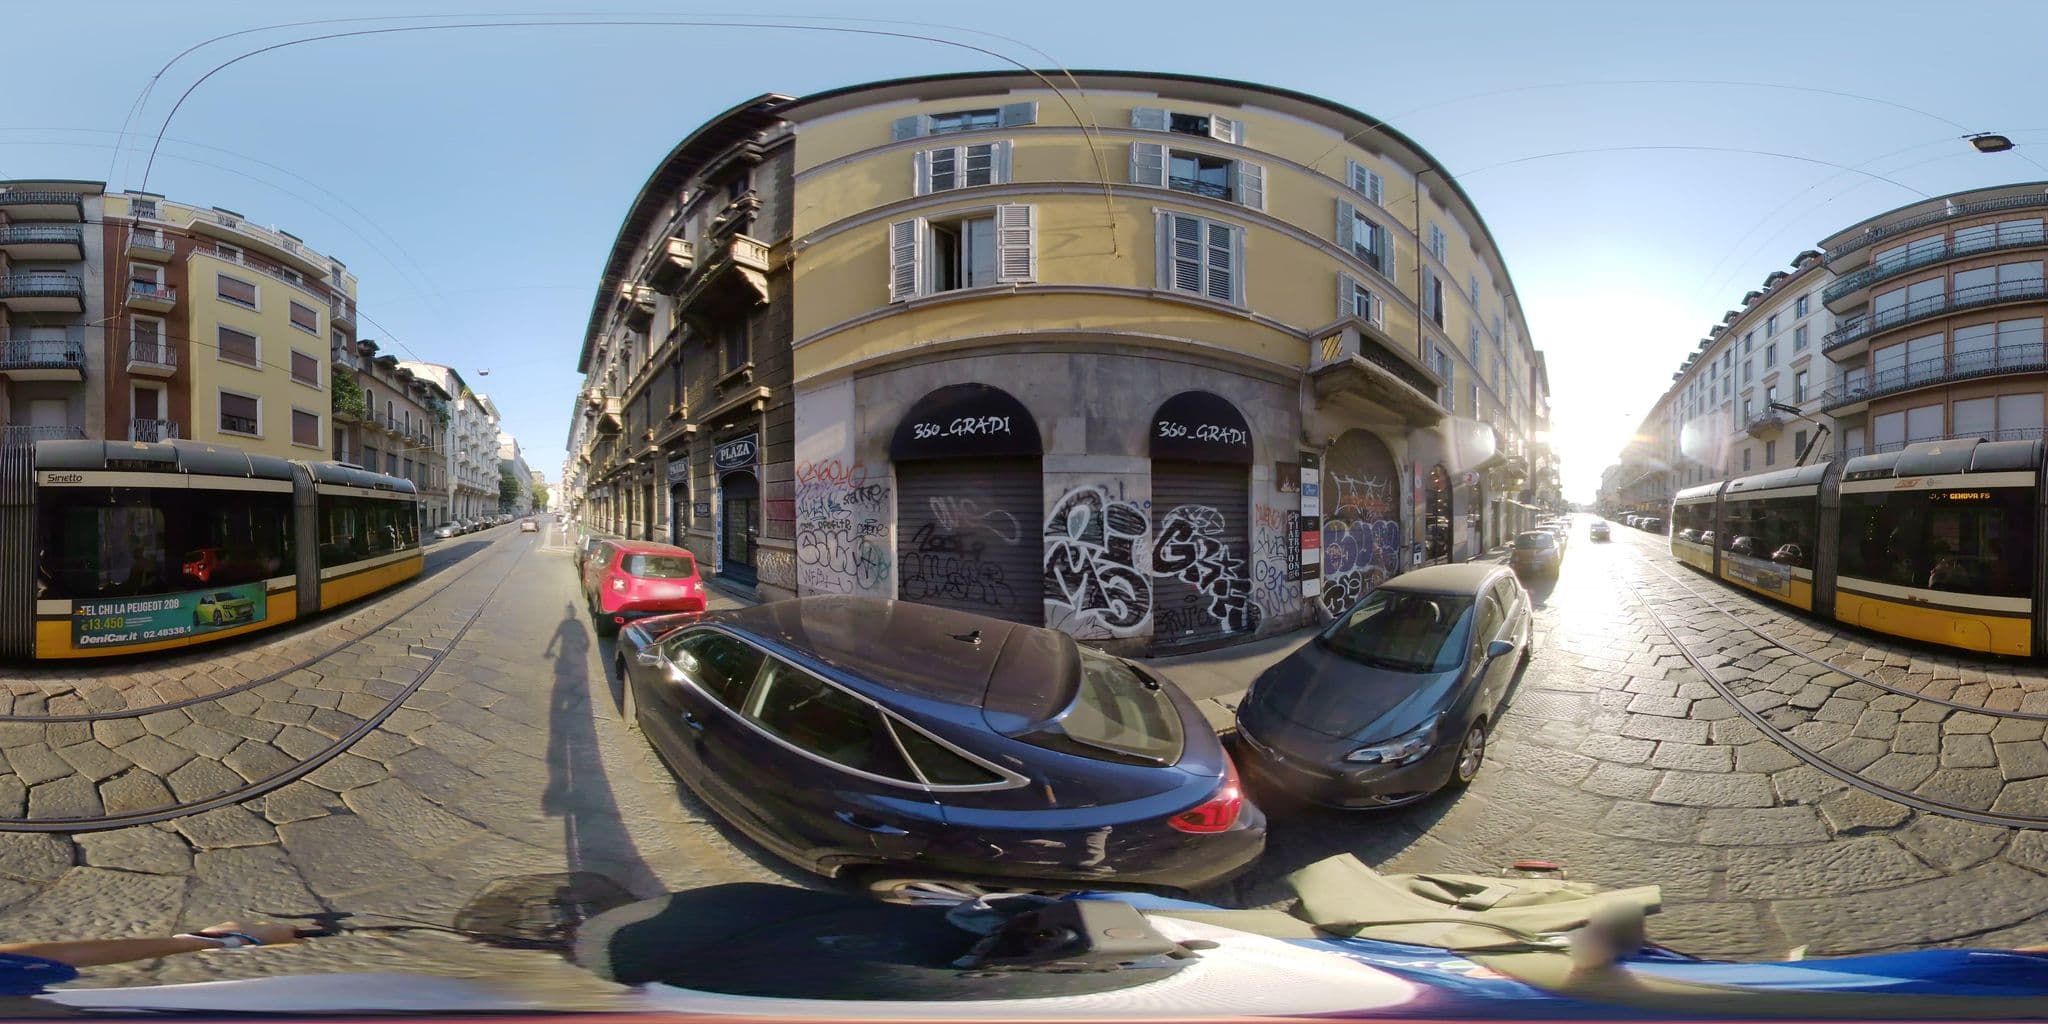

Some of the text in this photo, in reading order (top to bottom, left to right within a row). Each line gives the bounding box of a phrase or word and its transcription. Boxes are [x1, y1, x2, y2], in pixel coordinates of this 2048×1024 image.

[913, 416, 1011, 440] 360_GRADI
[1158, 421, 1247, 445] 360_GRADI
[720, 443, 750, 461] PLAZA
[1949, 492, 1979, 500] GENOVA
[98, 604, 113, 616] CHI
[114, 603, 126, 614] LA
[127, 600, 163, 613] PEUGEOT
[164, 599, 180, 610] 208
[79, 632, 138, 645] DeniCar.it
